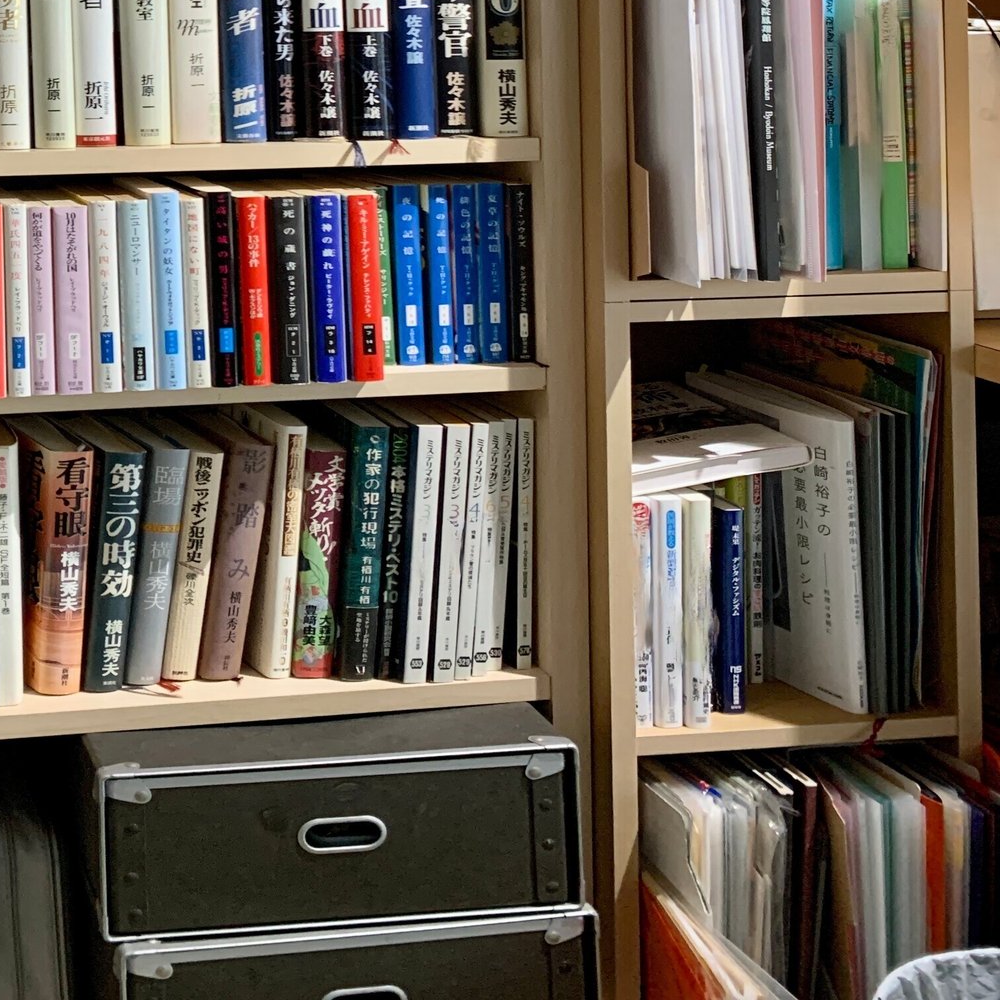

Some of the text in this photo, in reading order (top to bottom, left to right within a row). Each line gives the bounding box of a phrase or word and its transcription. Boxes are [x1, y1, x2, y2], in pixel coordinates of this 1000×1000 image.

[319, 35, 333, 57] 下巻
[362, 35, 377, 57] 上巻
[405, 15, 424, 64] 佐々木譲
[47, 78, 60, 112] 折原一
[141, 74, 155, 109] 折原一
[189, 53, 205, 87] 折原一
[319, 70, 337, 119] 佐々木譲
[363, 70, 381, 119] 佐々木譲
[446, 72, 466, 126] 佐々木譲
[498, 69, 518, 125] 横山秀夫
[0, 84, 18, 126] 折原一
[85, 80, 103, 120] 折原一
[232, 84, 257, 130] 折原一
[763, 66, 773, 171] Hoshokan Byodoin Museum
[32, 212, 43, 271] 何かが道をやってくる
[65, 212, 78, 273] 10月はたそがれの国
[130, 215, 141, 276] ニューロマンサー
[162, 207, 174, 276] タイタンの妖女
[283, 209, 297, 271] 死の蔵書
[321, 208, 335, 271] 死神の戯れ
[154, 466, 184, 506] 臨場
[326, 456, 346, 513] 文学賞
[421, 440, 434, 499] ミステリマガジン
[450, 439, 463, 499] ミステリマガジン
[473, 438, 484, 498] ミステリマガジン
[487, 435, 499, 495] ミステリマガジン
[501, 432, 513, 492] ミステリマガジン
[520, 431, 531, 491] ミステリマガジン
[54, 458, 90, 538] 看守眼
[186, 456, 213, 564] 戦後ニッポン犯罪史
[360, 449, 383, 550] 作家の犯行現場
[814, 446, 832, 537] 白崎裕子の
[100, 464, 144, 598] 第三の時効
[60, 551, 80, 612] 横山秀夫
[143, 541, 171, 610] 横山秀夫
[359, 556, 371, 605] 有栖川有栖
[732, 557, 741, 616] デジタル・ファシズム
[753, 552, 761, 589] お肉料理の
[223, 591, 242, 644] 横山秀夫
[318, 616, 332, 647] 大森望
[102, 621, 123, 676] 横山秀夫
